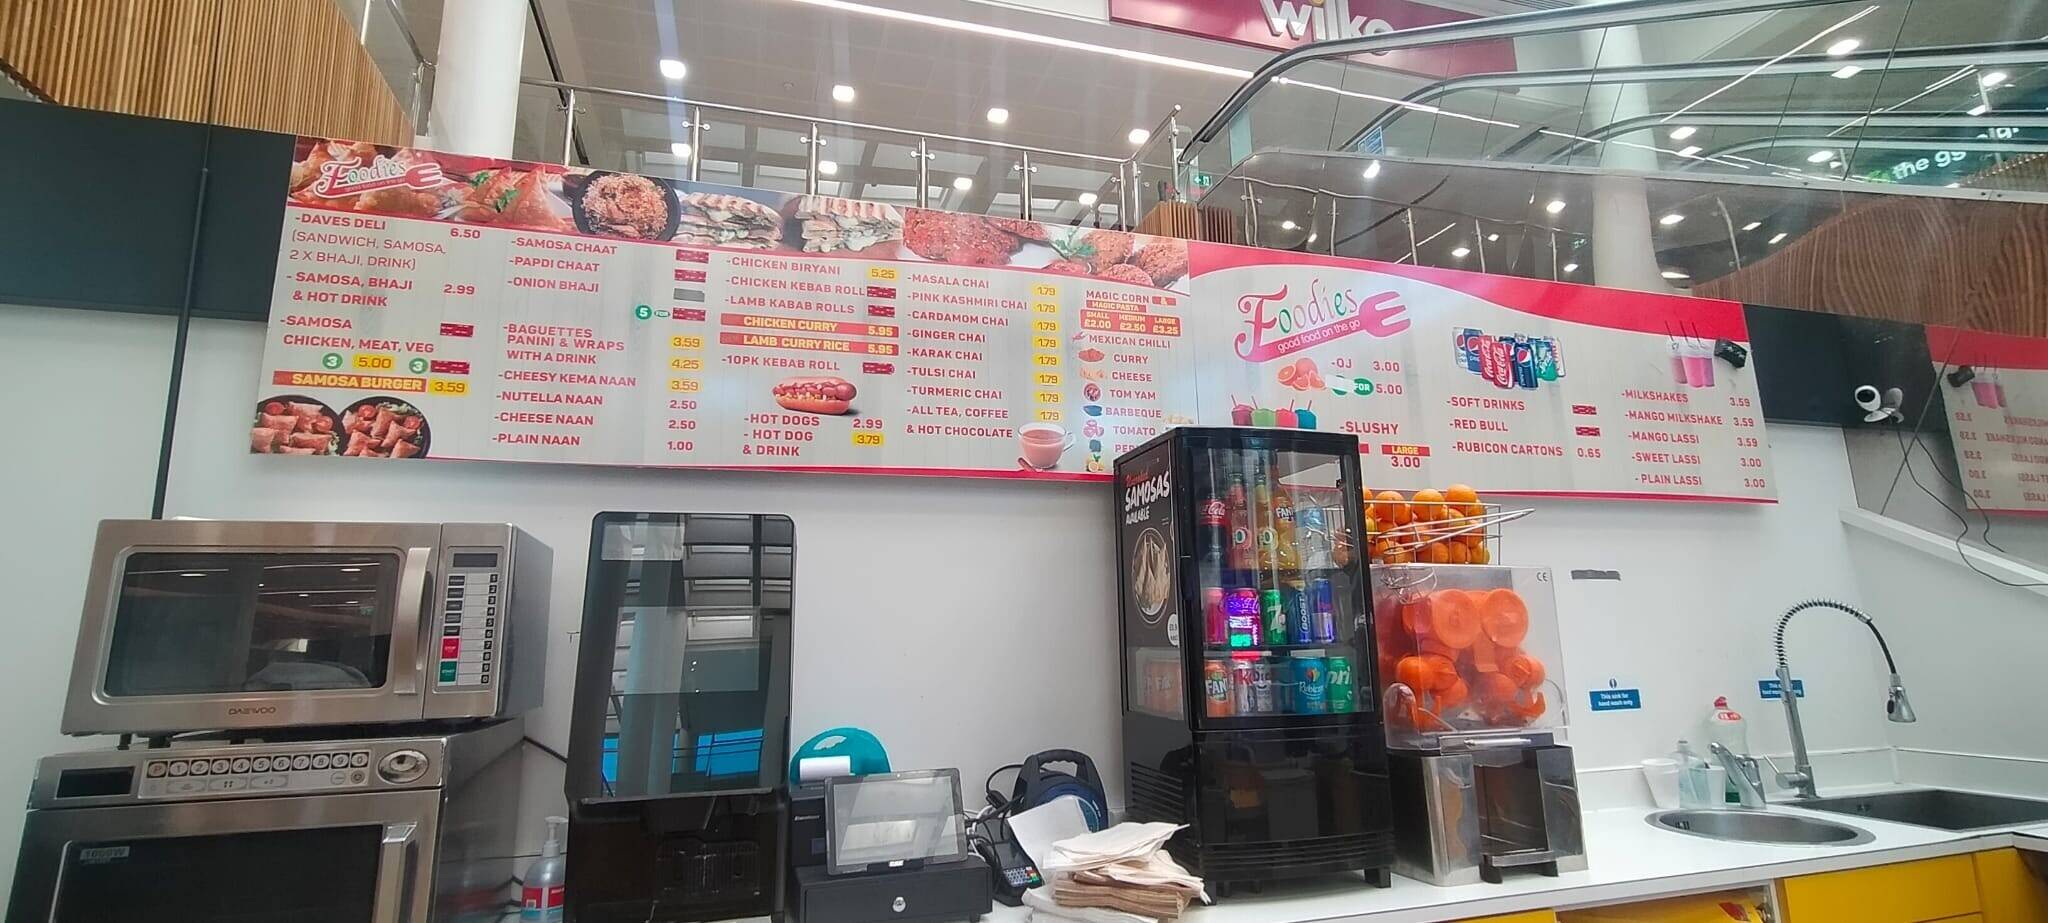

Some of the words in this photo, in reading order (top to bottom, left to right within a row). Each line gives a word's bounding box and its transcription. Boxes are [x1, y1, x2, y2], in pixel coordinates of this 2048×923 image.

[1892, 157, 1929, 180] the
[314, 155, 406, 197] Foodies
[296, 214, 350, 227] -DAVES
[354, 218, 385, 230] DELI
[450, 228, 480, 238] 6.50
[292, 229, 379, 249] (SANDWICH,
[384, 240, 446, 254] SAMOSA,
[511, 237, 572, 250] -SAMOSA
[575, 243, 617, 255] CHAAT
[290, 250, 299, 260] 2
[302, 251, 312, 261] X
[317, 252, 363, 266] BHAJI,
[368, 256, 416, 270] DRINK)
[509, 257, 554, 268] -PAPDI
[557, 260, 599, 272] CHAAT
[727, 257, 787, 270] -CHICKEN
[791, 262, 840, 275] BIRYANI
[872, 269, 895, 279] 5.25
[296, 272, 364, 287] SAMOSA,
[369, 278, 412, 290] BHAJI
[508, 277, 555, 289] -ONION
[559, 282, 599, 292] BHAJI
[726, 276, 786, 289] -CHICKEN
[791, 282, 831, 293] KEBAB
[835, 285, 865, 296] ROLL
[907, 274, 960, 285] -MASALA
[962, 279, 989, 288] CHAI
[444, 284, 474, 295] 2.99
[293, 291, 302, 300] &
[307, 292, 338, 303] HOT
[341, 294, 388, 306] DRINK
[907, 292, 940, 303] -PINK
[943, 295, 998, 307] KASHMIRI
[1001, 300, 1027, 310] CHAI
[1086, 290, 1119, 300] MAGIC
[1122, 294, 1149, 303] CORN
[725, 296, 765, 307] -LAMB
[770, 299, 812, 309] KABAB
[816, 303, 855, 313] ROLLS
[280, 315, 352, 329] -SAMOSA
[907, 311, 979, 324] -CARDAMOM
[982, 316, 1008, 326] CHAI
[1234, 278, 1358, 358] Foodies
[503, 324, 593, 338] -BAGUETTES
[743, 316, 795, 329] CHICKEN
[798, 321, 838, 332] CURRY
[868, 326, 893, 336] 5.95
[1085, 319, 1111, 329] £2.00
[1120, 323, 1146, 332] £2.50
[1153, 326, 1178, 335] £3.25
[507, 335, 554, 347] PANINI
[560, 338, 568, 347] &
[574, 339, 624, 350] WRAPS
[674, 337, 700, 347] 3.59
[907, 330, 955, 340] -GINGER
[958, 333, 985, 342] CHAI
[1089, 334, 1136, 346] MEXICAN
[1139, 338, 1170, 348] CHILLI
[1277, 337, 1300, 353] good
[1301, 329, 1320, 345] food
[1322, 327, 1334, 337] on
[1334, 321, 1349, 333] the
[1349, 319, 1360, 331] go
[283, 335, 354, 349] CHICKEN,
[359, 340, 401, 352] MEAT,
[406, 343, 434, 352] VEG
[743, 335, 777, 346] LAMB
[782, 337, 822, 349] CURRY
[823, 341, 850, 351] RICE
[868, 344, 892, 354] 5.95
[507, 350, 542, 361] WITH
[544, 353, 553, 362] A
[556, 353, 596, 364] DRINK
[907, 348, 952, 359] -KARAK
[955, 351, 982, 360] CHAI
[1114, 354, 1148, 364] CURRY
[358, 357, 391, 368] 5.00
[672, 359, 699, 369] 4.25
[721, 355, 759, 365] -10PK
[763, 358, 805, 368] KEBAB
[809, 361, 840, 370] ROLL
[1331, 359, 1352, 368] -OJ
[1373, 361, 1400, 372] 3.00
[498, 370, 557, 382] -CHEESY
[560, 374, 597, 384] KEMA
[599, 376, 636, 386] NAAN
[907, 367, 945, 377] -TULSI
[948, 370, 976, 379] CHAI
[1112, 371, 1152, 382] CHEESE
[292, 374, 358, 388] SAMOSA
[361, 378, 422, 390] BURGER
[435, 382, 464, 393] 3.59
[672, 381, 698, 391] 3.59
[907, 386, 972, 398] -TURMERIC
[975, 390, 1002, 399] CHAI
[1110, 389, 1132, 399] TOM
[1135, 391, 1156, 400] YAM
[1376, 385, 1403, 394] 5.00
[1622, 389, 1688, 403] -MILKSHAKES
[496, 391, 562, 403] -NUTELLA
[565, 394, 602, 405] NAAN
[1447, 397, 1480, 408] -SOFT
[1483, 399, 1525, 410] DRINKS
[1730, 397, 1750, 407] 3.59
[495, 412, 553, 423] -CHEESE
[556, 414, 593, 425] NAAN
[907, 406, 933, 415] -ALL
[936, 407, 962, 418] TEA,
[965, 408, 1008, 418] COFFEE
[1106, 407, 1162, 418] BARBEQUE
[1625, 411, 1665, 421] -MANGO
[1668, 415, 1723, 425] MILKSHAKE
[744, 414, 778, 425] -HOT
[783, 416, 819, 426] DOGS
[853, 419, 882, 429] 2.99
[1449, 419, 1477, 430] -RED
[1480, 421, 1508, 431] BULL
[1733, 417, 1754, 427] 3.59
[907, 425, 914, 433] &
[918, 425, 942, 434] HOT
[945, 426, 1013, 438] CHOCOLATE
[1113, 426, 1156, 435] TOMATO
[1340, 421, 1398, 434] -SLUSHY
[493, 433, 538, 444] -PLAIN
[542, 435, 580, 445] NAAN
[753, 429, 780, 439] HOT
[785, 431, 813, 441] DOG
[857, 435, 880, 444] 3.79
[1628, 431, 1669, 442] -MANGO
[1671, 434, 1699, 443] LASSI
[668, 441, 693, 450] 1.00
[1452, 441, 1508, 454] -RUBICON
[1511, 445, 1563, 456] CARTONS
[1737, 437, 1758, 447] 3.59
[743, 445, 751, 454] &
[756, 446, 800, 456] DRINK
[1392, 446, 1419, 455] LARGE
[1577, 448, 1601, 458] 0.65
[1391, 456, 1420, 468] 3.00
[1632, 452, 1669, 463] -SWEET
[1672, 454, 1700, 464] LASSI
[1740, 458, 1761, 467] 3.00
[1641, 474, 1671, 484] PLAIN
[1673, 476, 1702, 486] LASSI
[1744, 478, 1765, 488] 3.00
[1125, 471, 1169, 512] SAMOSAS
[228, 707, 276, 715] DAEWOO
